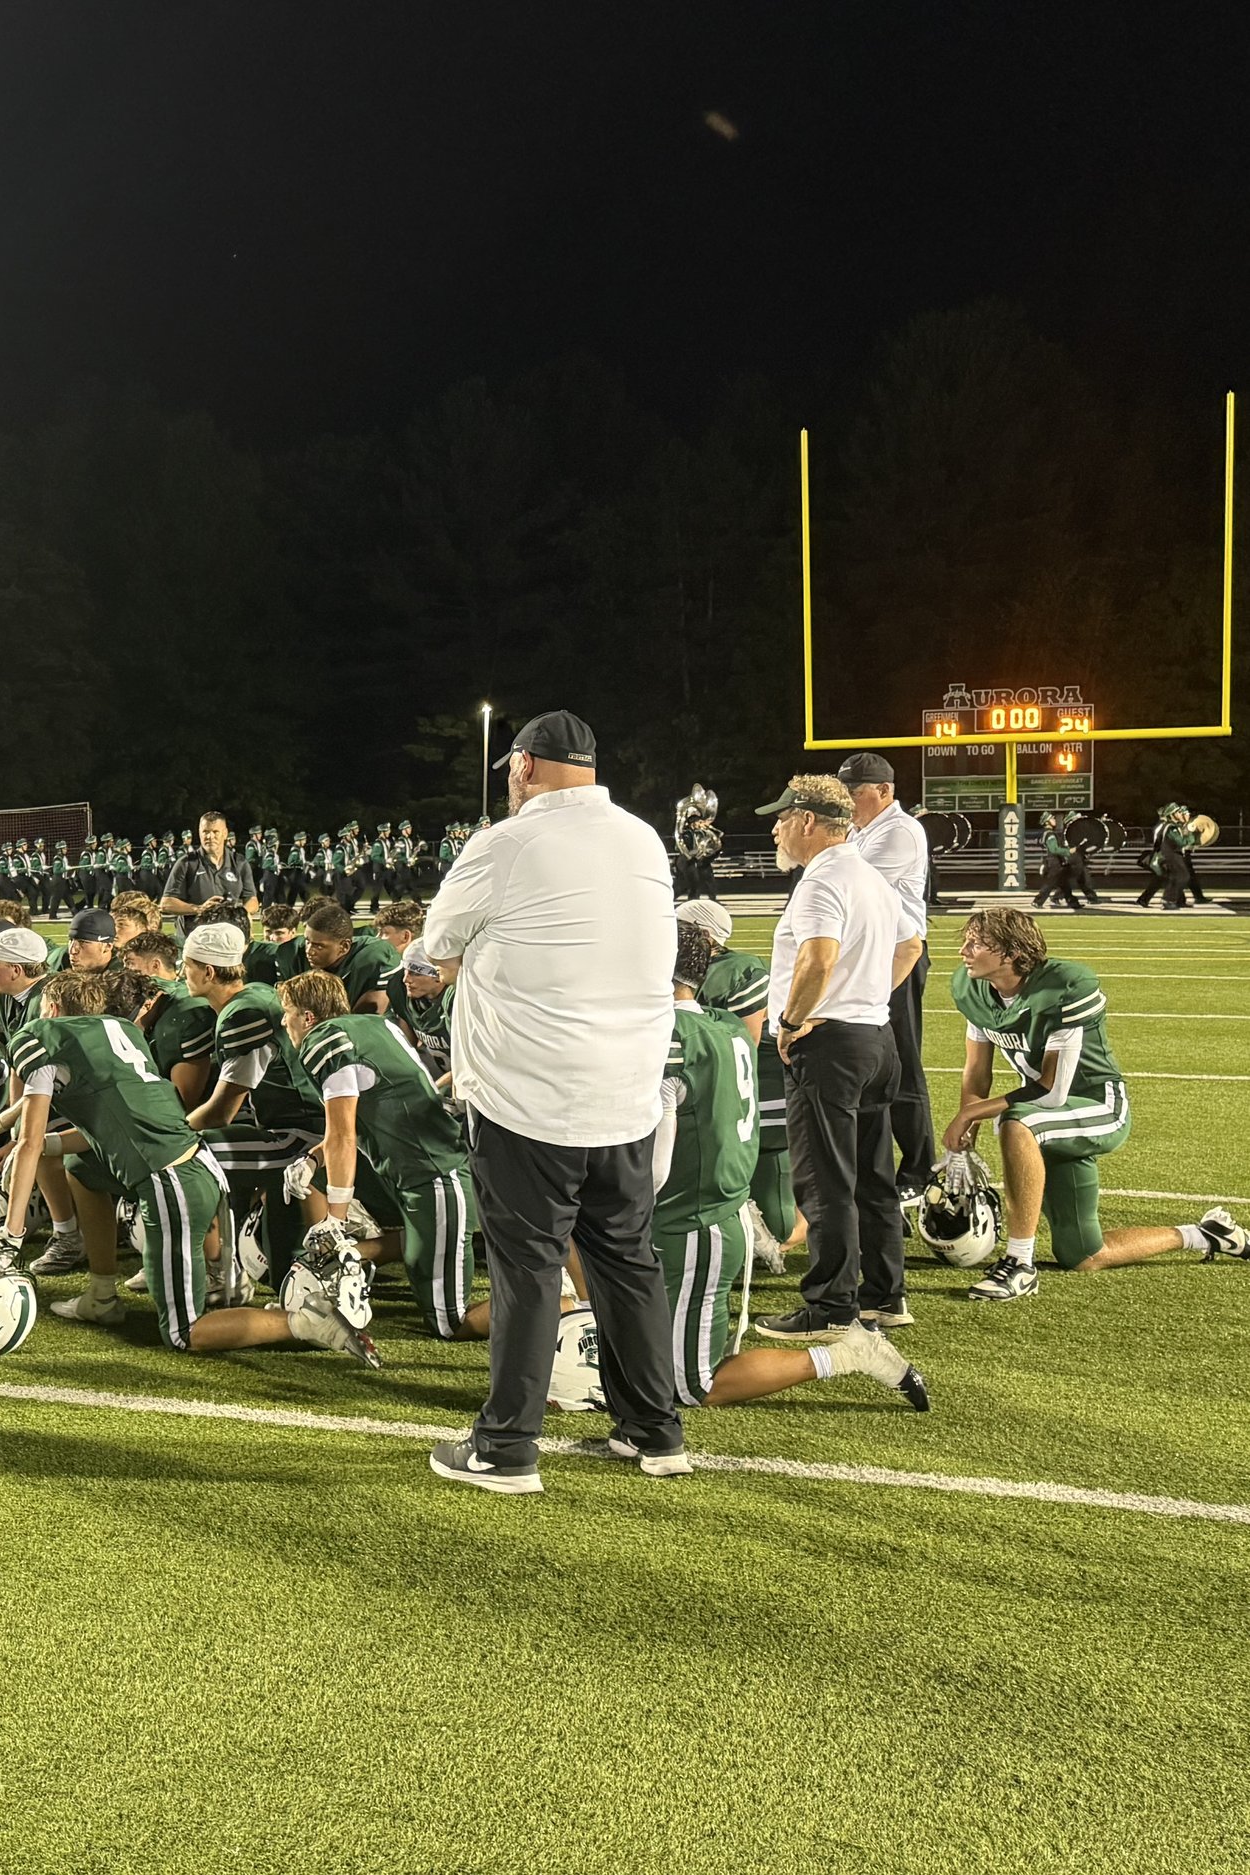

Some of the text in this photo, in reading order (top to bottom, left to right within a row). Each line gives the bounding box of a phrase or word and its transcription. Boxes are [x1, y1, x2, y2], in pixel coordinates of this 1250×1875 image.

[942, 683, 1083, 709] AURORA
[1057, 707, 1091, 718] GUEST
[935, 723, 957, 739] 14
[927, 746, 957, 757] DOWN
[966, 744, 995, 756] TO GO
[1016, 742, 1053, 755] BALL ON
[1062, 742, 1083, 753] QTR
[1058, 753, 1073, 772] 4
[1003, 810, 1020, 887] AURORA
[100, 1018, 162, 1083] 4
[731, 1036, 756, 1142] 9
[577, 1335, 598, 1356] AURO
